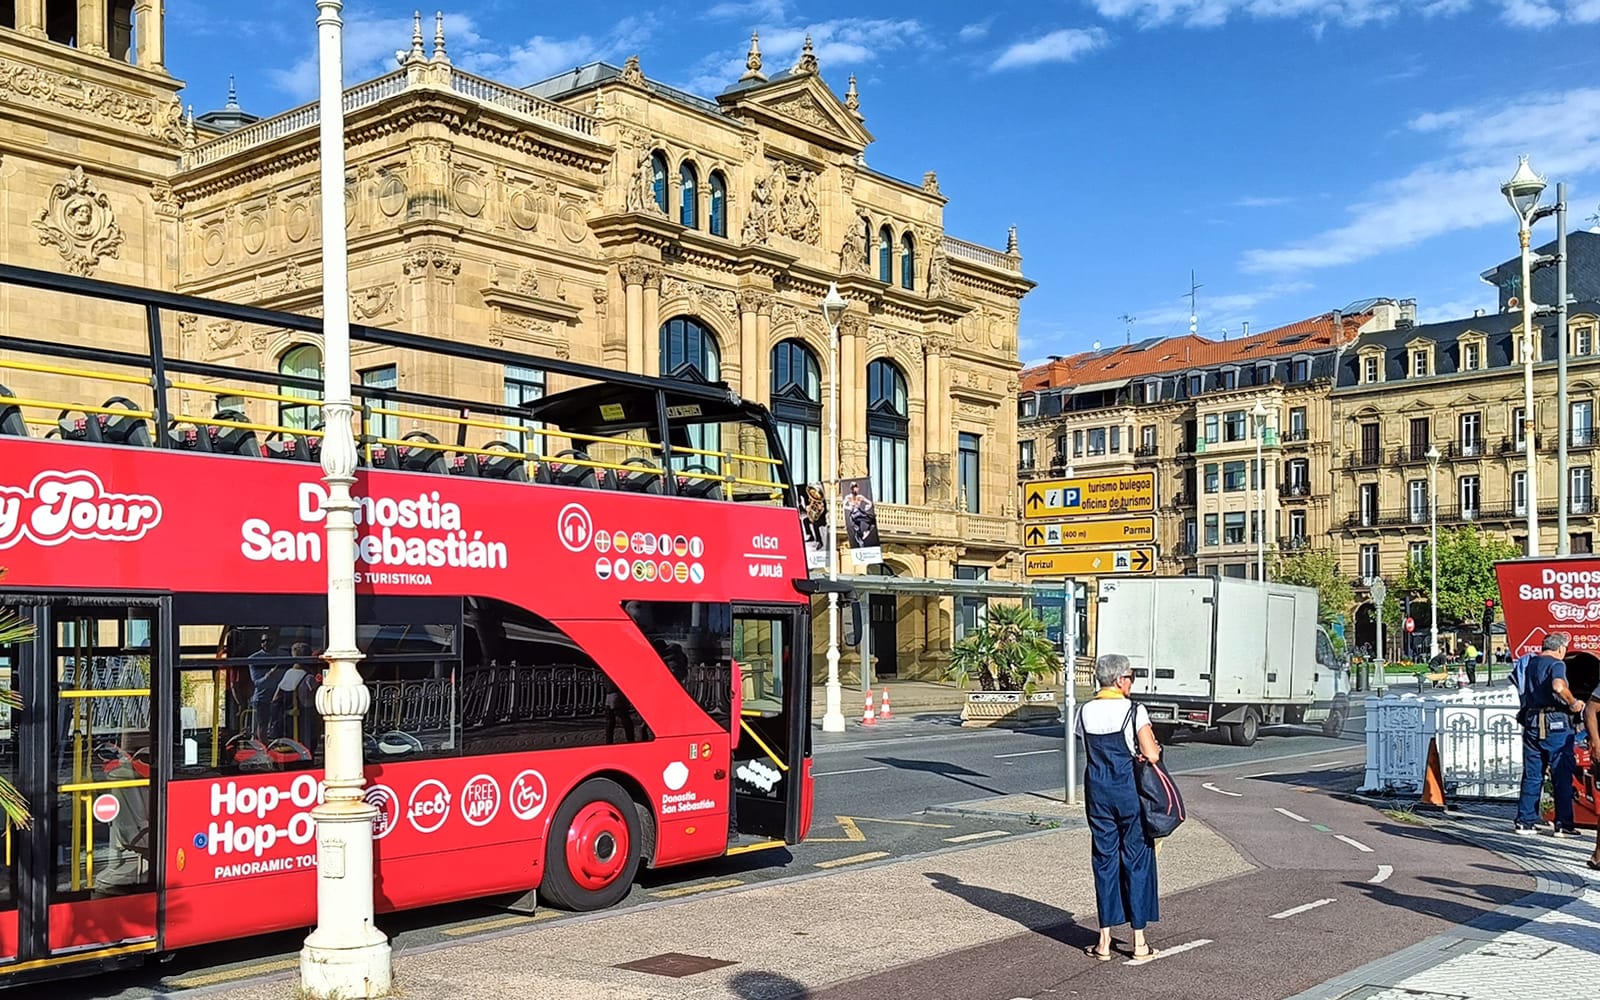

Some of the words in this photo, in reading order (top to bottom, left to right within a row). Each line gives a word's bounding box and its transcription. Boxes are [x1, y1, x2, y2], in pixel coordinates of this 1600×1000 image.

[1088, 481, 1117, 493] turismo
[1119, 479, 1150, 492] bulegoa
[30, 477, 156, 538] Tour
[297, 482, 461, 531] Dnostia
[1081, 498, 1107, 510] oficina
[1109, 496, 1119, 509] de
[1120, 495, 1150, 507] turismo
[752, 533, 779, 549] alsa
[1063, 530, 1077, 539] (400
[1123, 526, 1151, 535] Parma
[241, 518, 321, 562] San
[353, 527, 508, 569] ebastián
[1028, 560, 1054, 569] Arrizul
[365, 572, 432, 585] TURISTIKOA
[1519, 584, 1555, 600] San
[1550, 602, 1585, 620] City
[468, 783, 494, 801] FREE
[414, 798, 446, 817] ECO
[469, 800, 493, 817] APP
[661, 804, 677, 814] San
[207, 811, 316, 857] Hop-O
[214, 857, 293, 879] PANORAMIC
